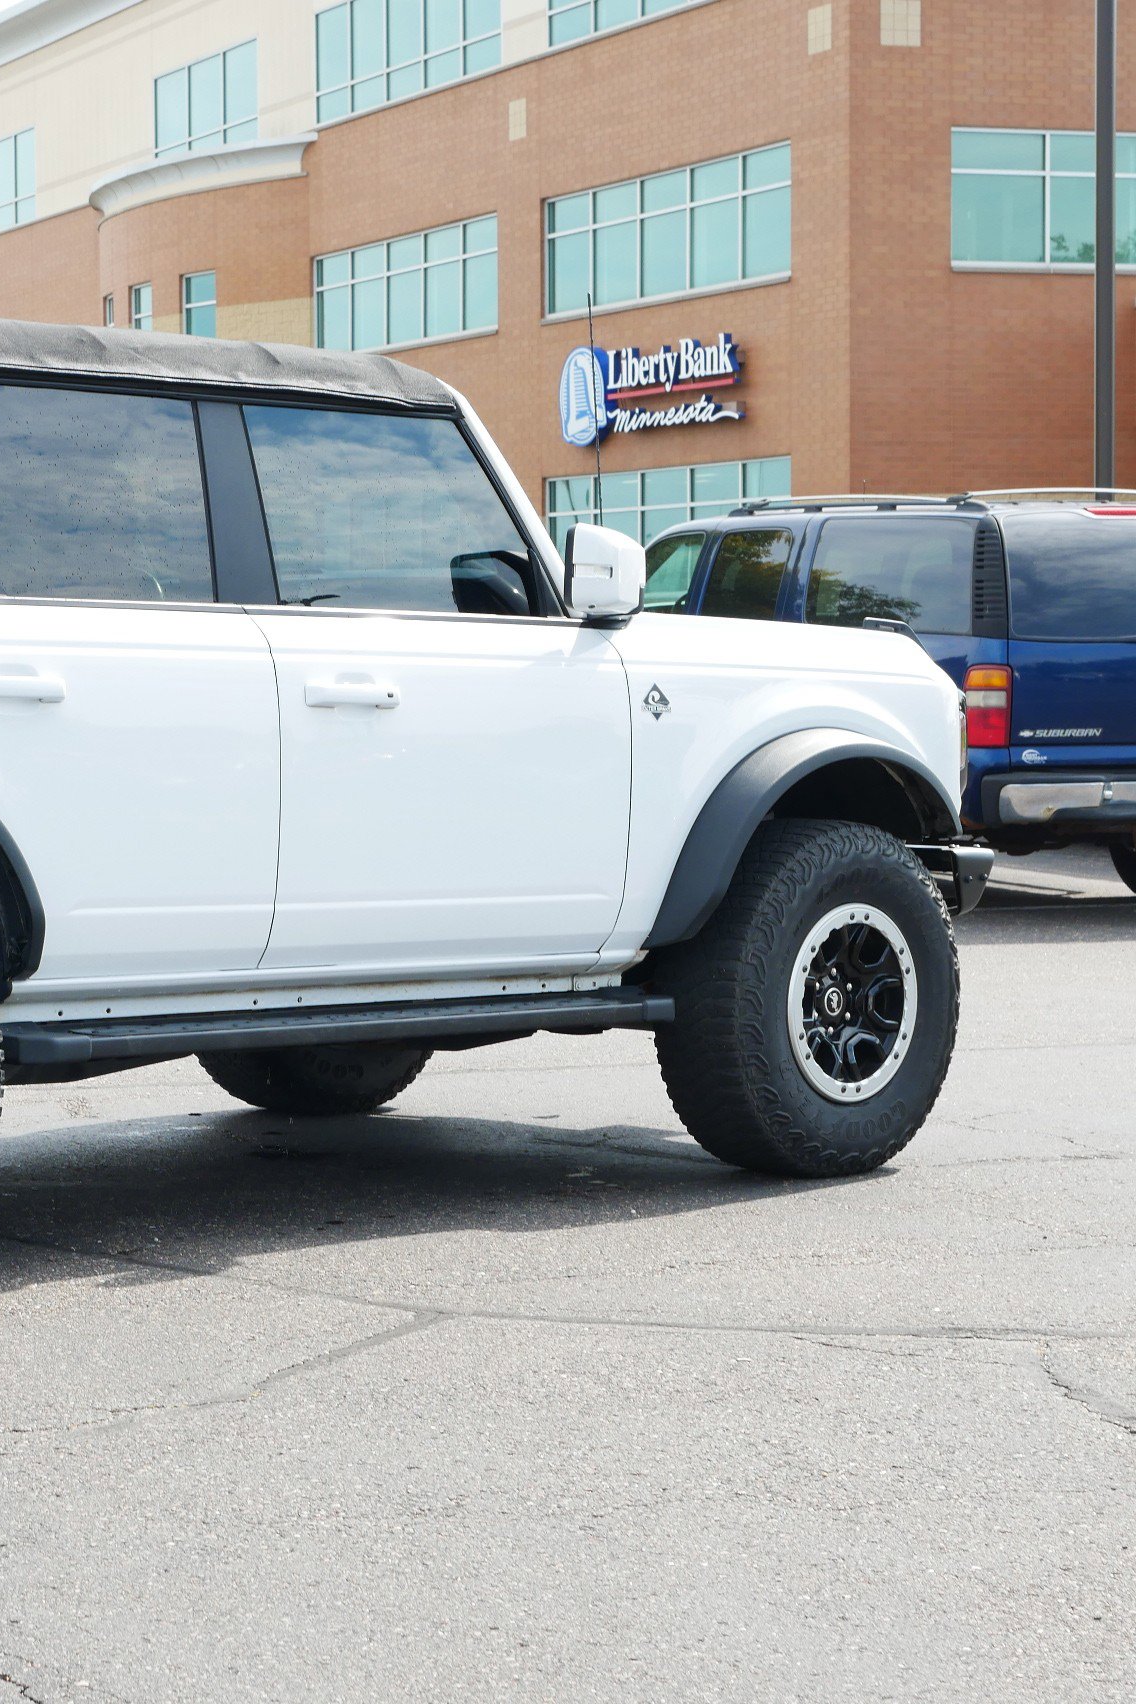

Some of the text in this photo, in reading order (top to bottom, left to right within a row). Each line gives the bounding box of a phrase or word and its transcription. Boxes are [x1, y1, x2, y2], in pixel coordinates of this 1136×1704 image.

[607, 333, 734, 392] Liberty Bank
[1034, 728, 1103, 738] SUBURBAN
